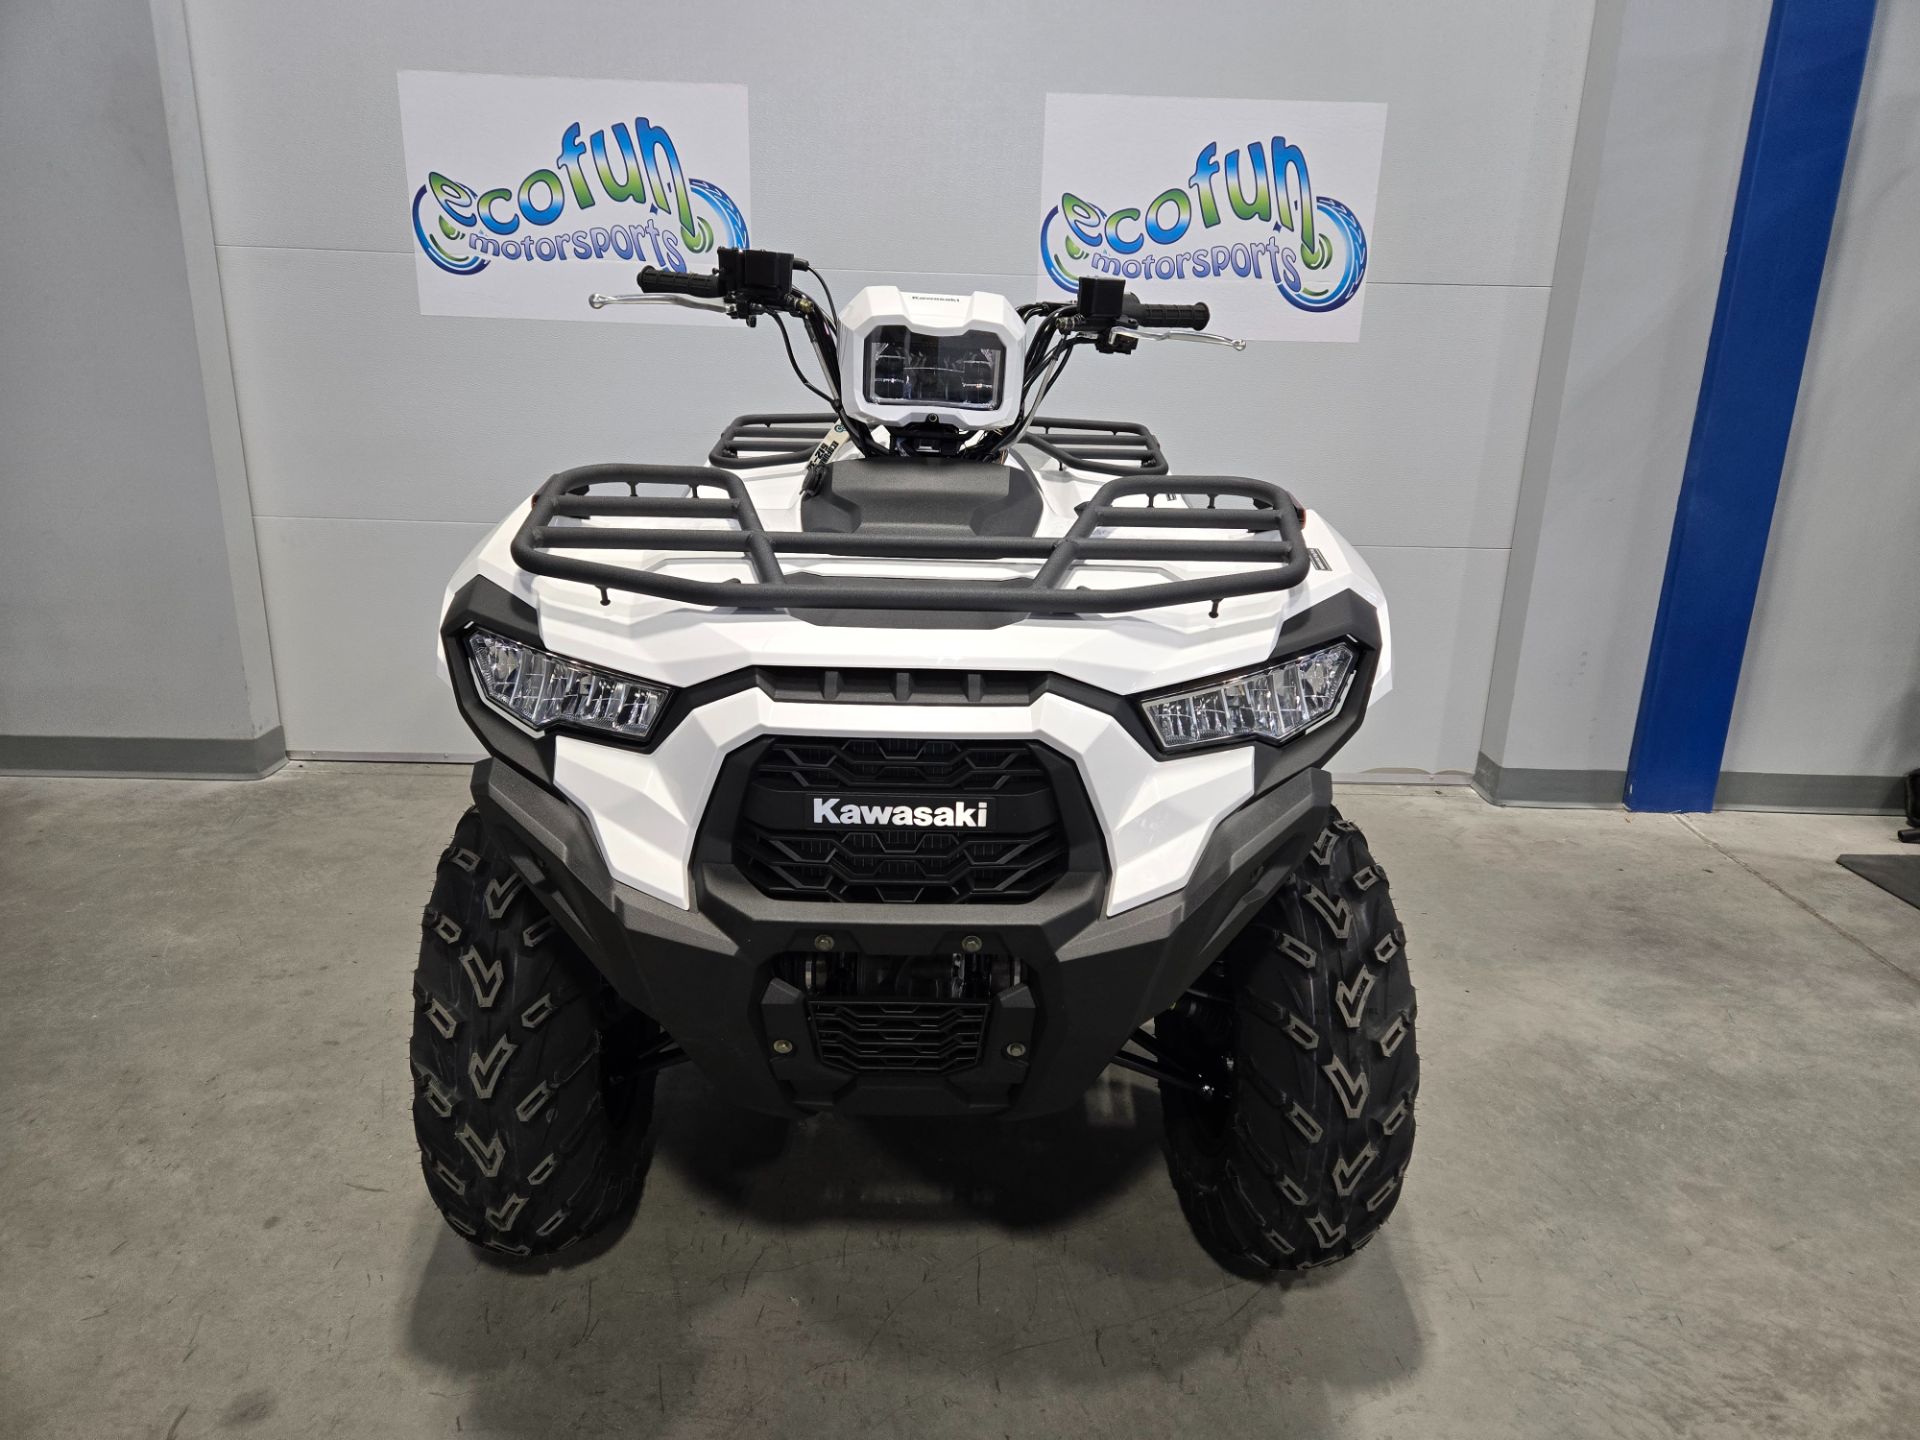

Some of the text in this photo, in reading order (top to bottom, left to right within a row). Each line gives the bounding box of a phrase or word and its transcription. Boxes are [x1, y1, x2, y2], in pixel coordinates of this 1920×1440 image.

[428, 116, 696, 238] ecofun
[1061, 136, 1316, 255] ecofun
[468, 218, 688, 274] motorsports
[1091, 236, 1302, 293] motorsports
[813, 798, 988, 828] Kawasaki
